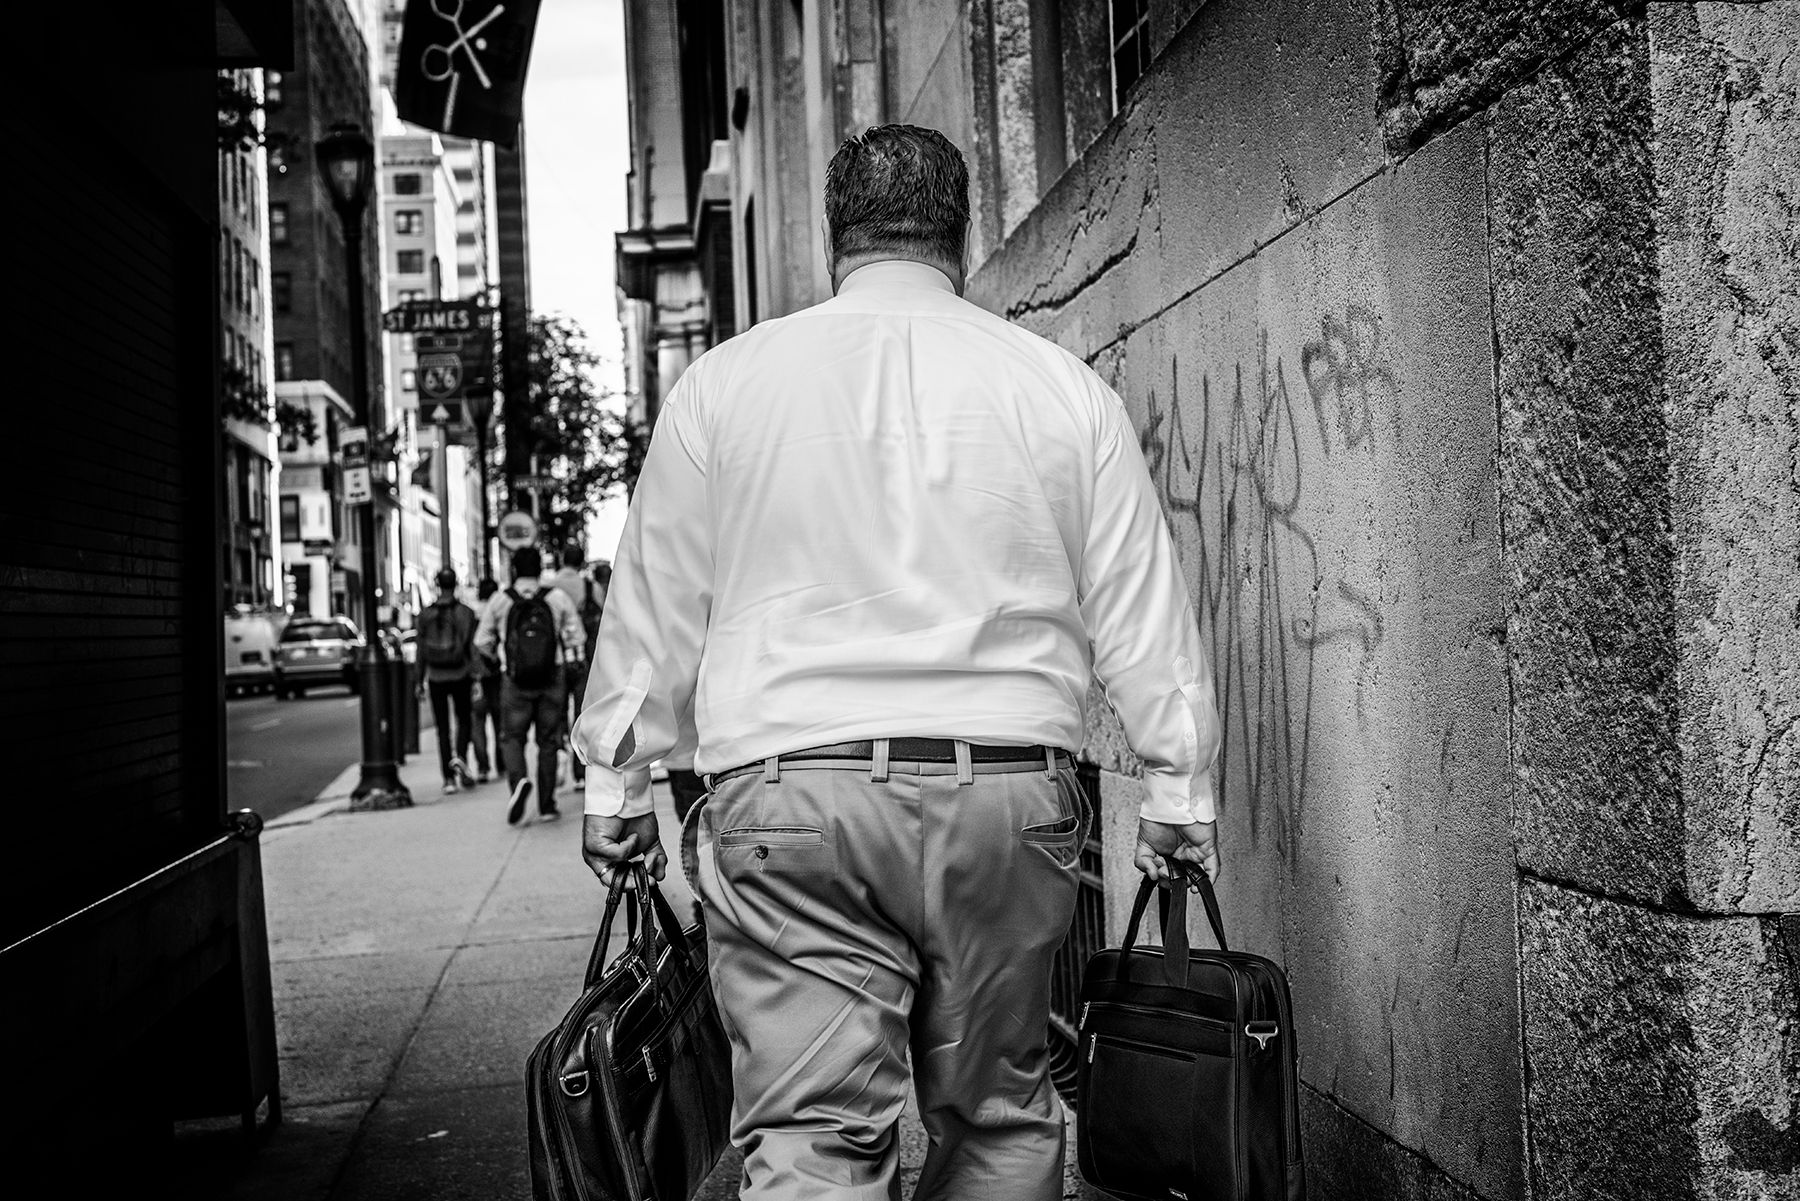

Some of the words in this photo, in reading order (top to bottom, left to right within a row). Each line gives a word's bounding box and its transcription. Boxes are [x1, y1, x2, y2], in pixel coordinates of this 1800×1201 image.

[385, 311, 405, 330] ST
[412, 309, 470, 329] JAMES
[425, 366, 457, 391] 676
